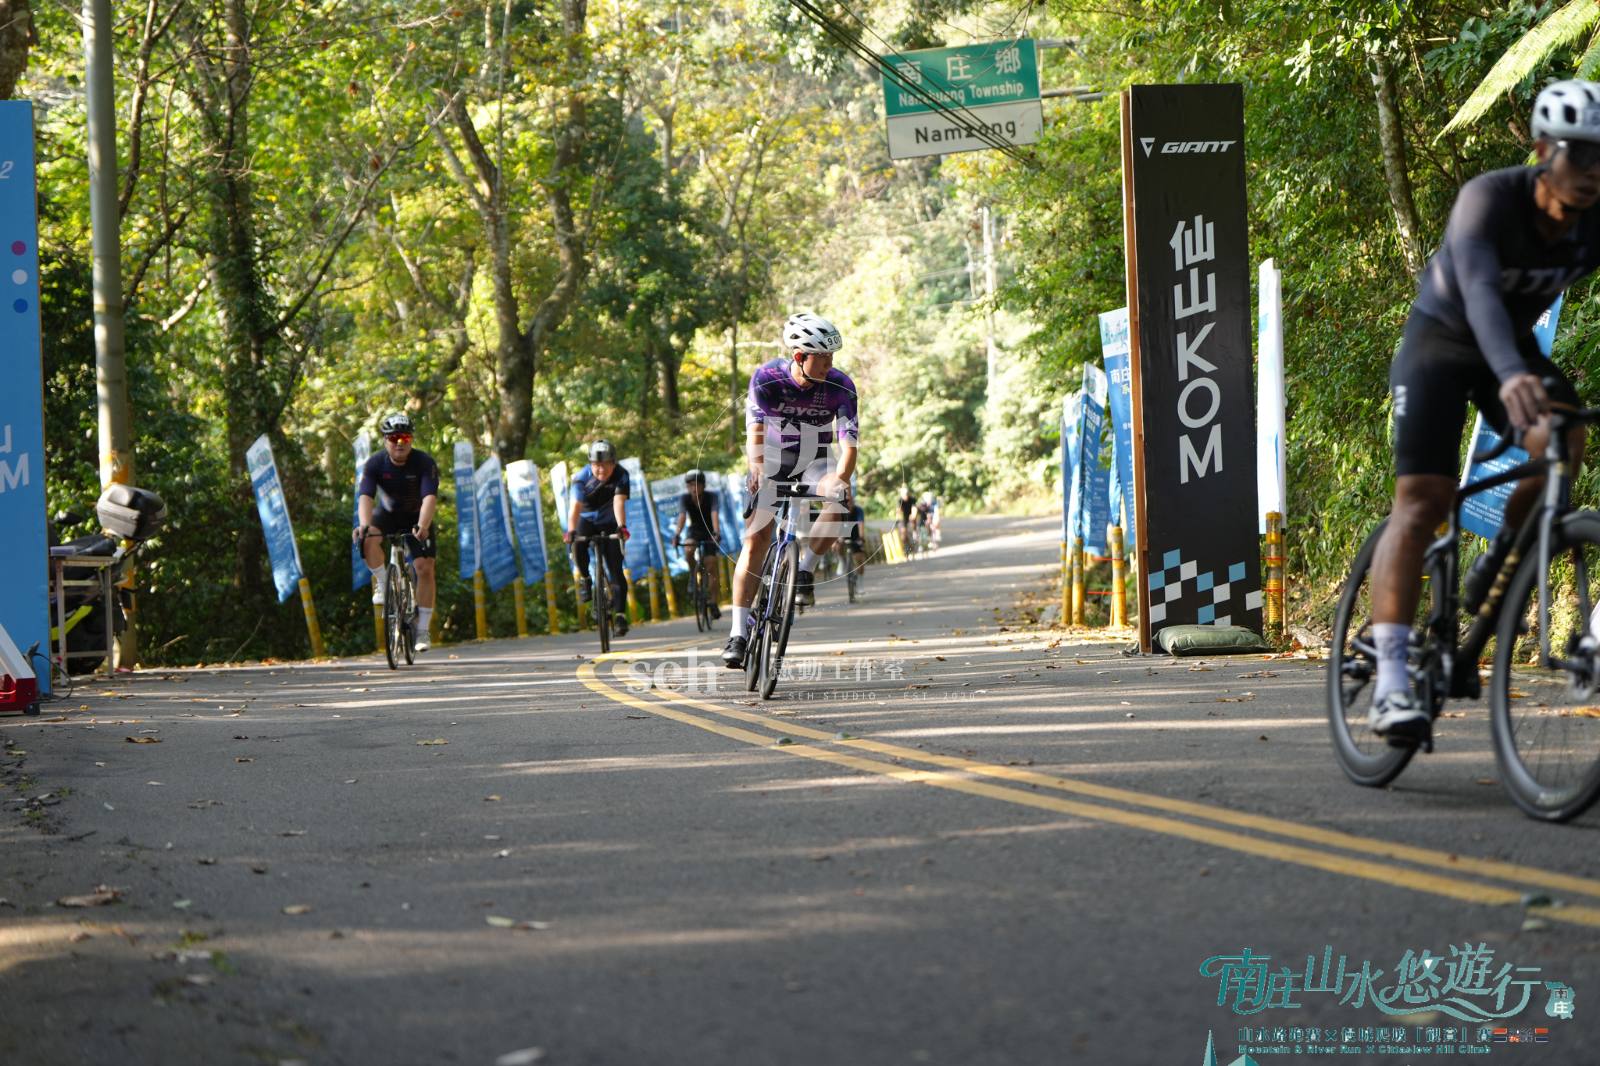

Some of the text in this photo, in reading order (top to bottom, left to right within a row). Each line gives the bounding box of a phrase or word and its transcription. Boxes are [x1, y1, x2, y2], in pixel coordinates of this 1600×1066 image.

[896, 47, 1021, 86] 南庄鄉
[969, 80, 1025, 99] Township
[1160, 140, 1237, 154] GIANT
[770, 402, 831, 416] Jayco
